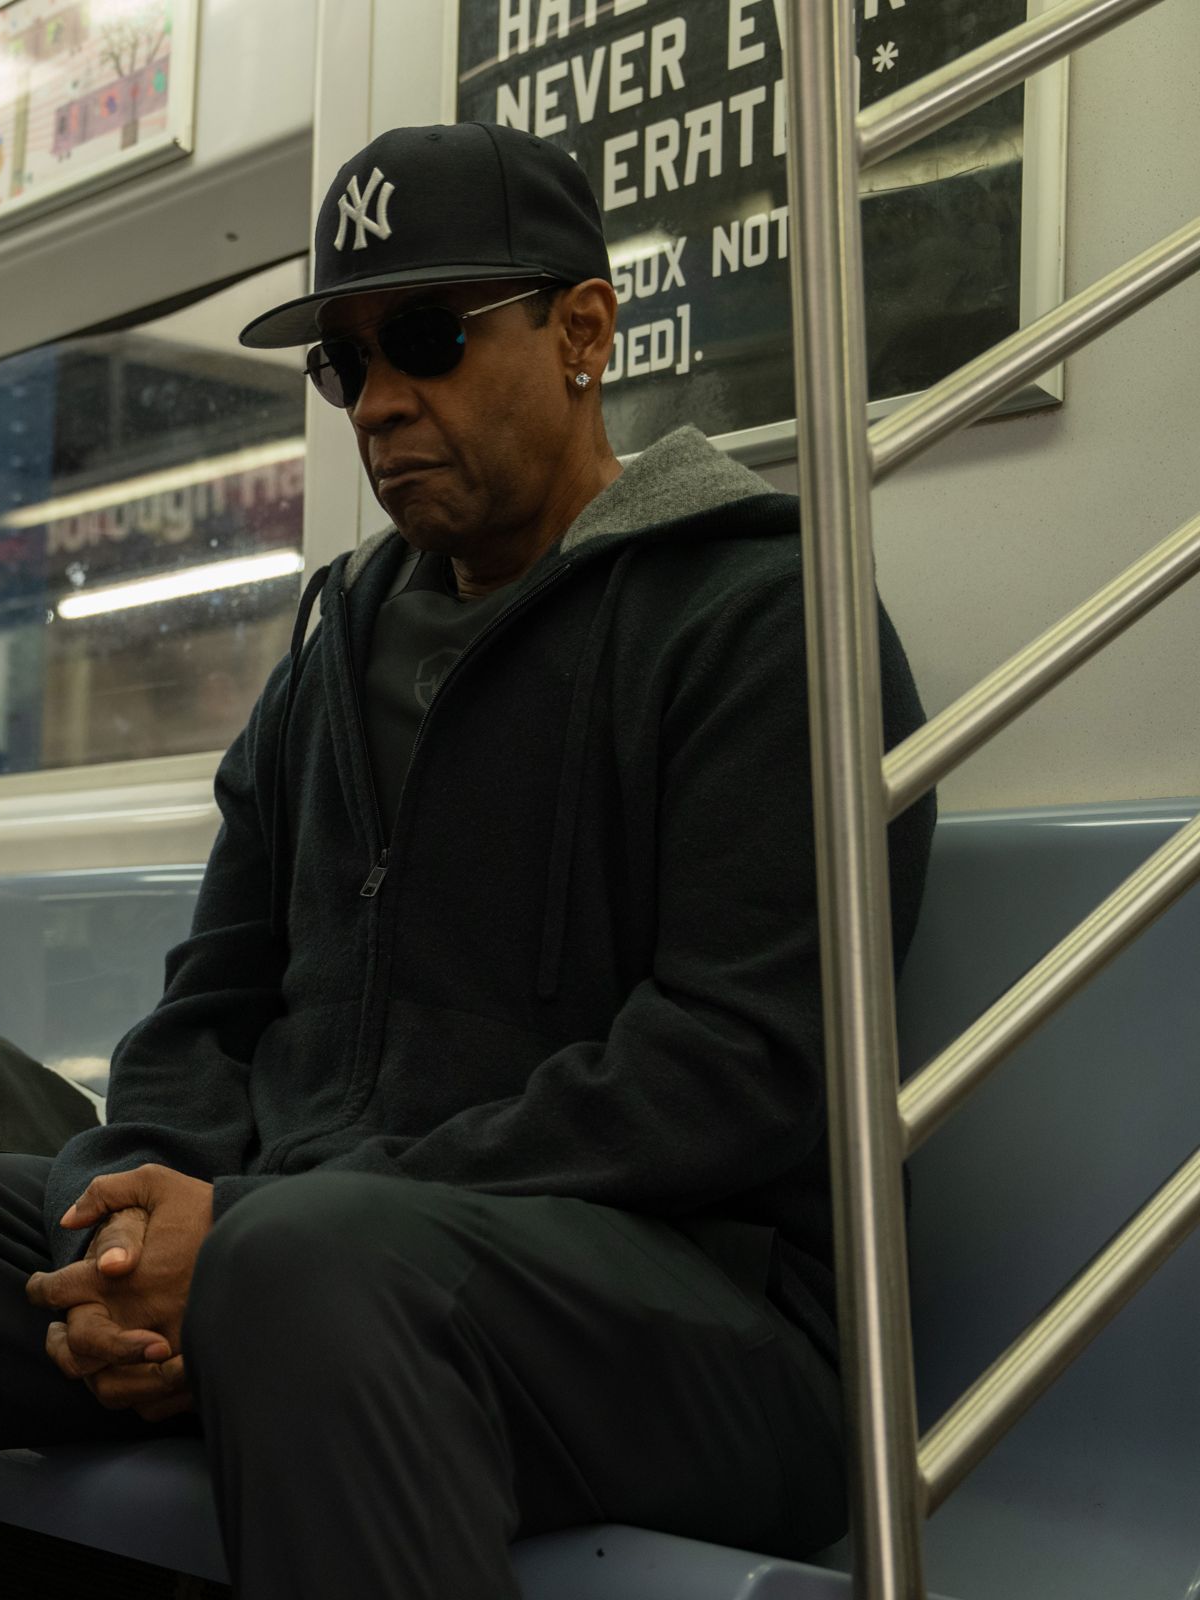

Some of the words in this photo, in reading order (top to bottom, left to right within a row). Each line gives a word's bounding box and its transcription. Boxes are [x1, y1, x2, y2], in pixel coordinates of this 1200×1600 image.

[496, 16, 687, 138] NEVER
[498, 0, 650, 62] HA
[333, 166, 396, 252] NY
[611, 236, 688, 305] SOX
[712, 205, 789, 278] NOT
